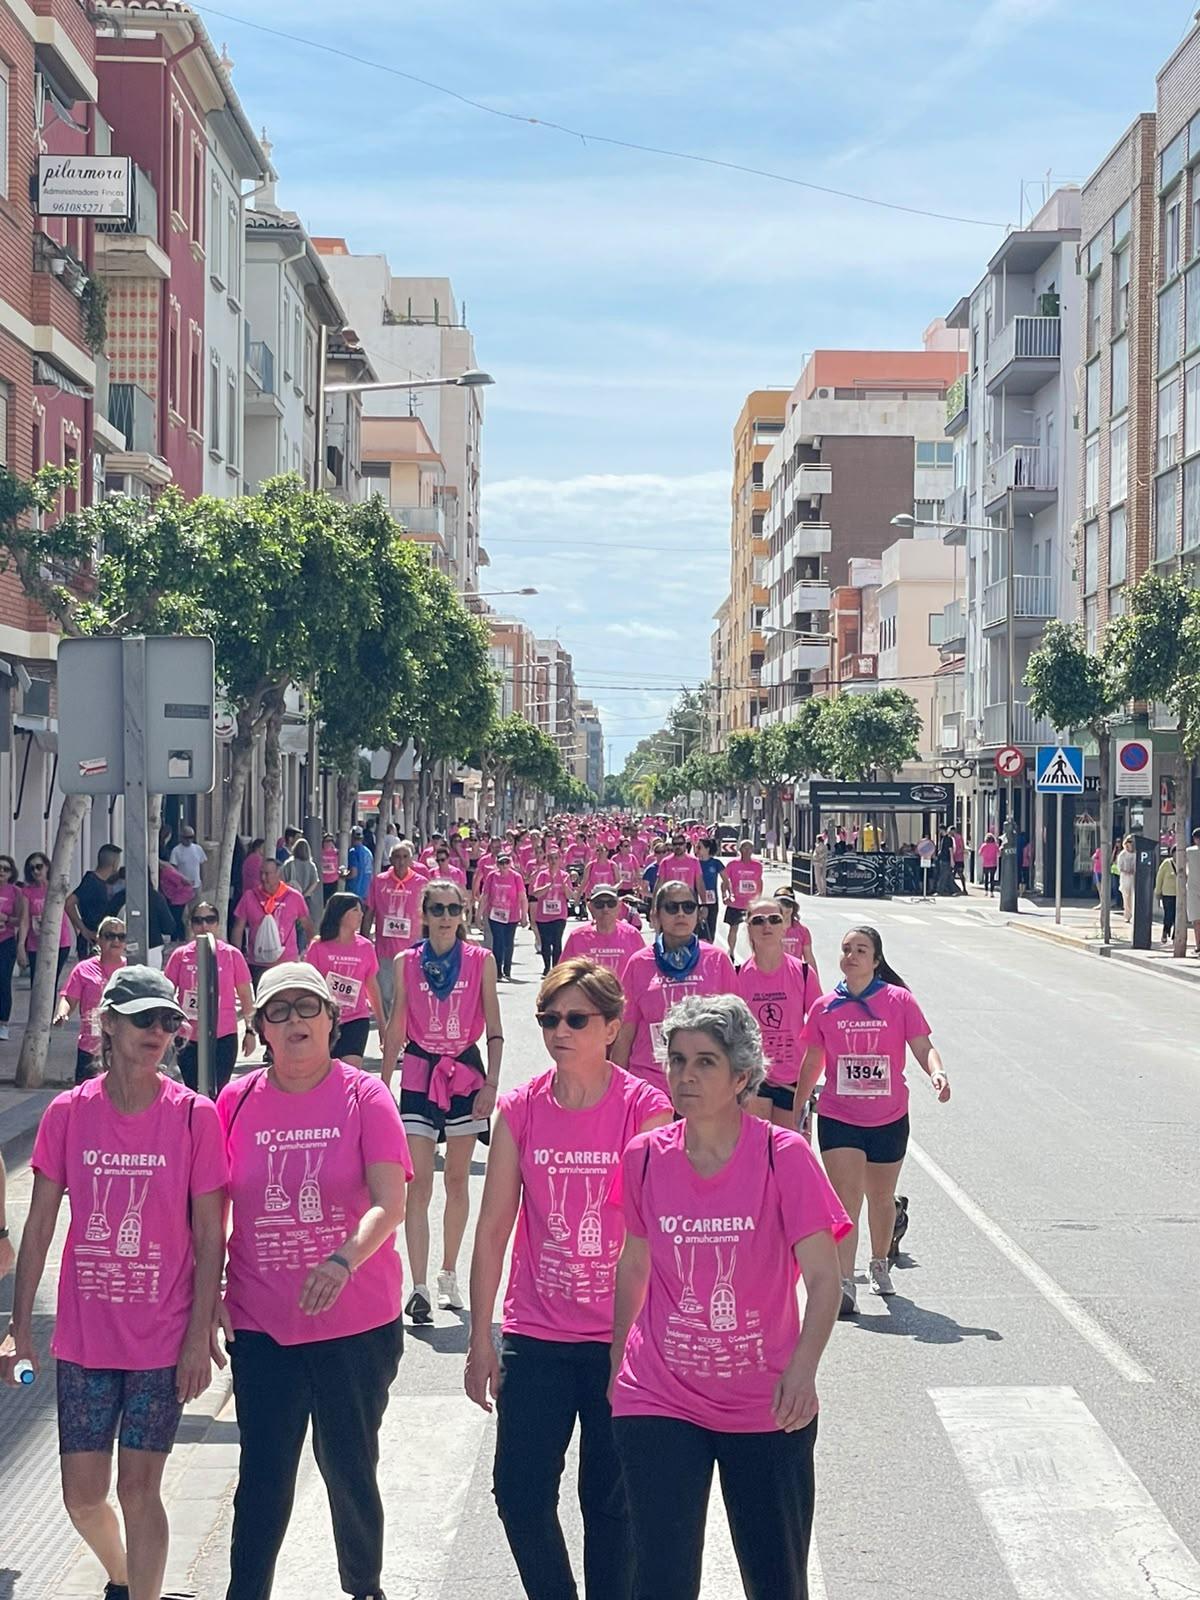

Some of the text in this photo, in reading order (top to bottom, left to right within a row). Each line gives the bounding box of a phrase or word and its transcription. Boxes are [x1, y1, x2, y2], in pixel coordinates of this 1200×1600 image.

[43, 159, 122, 187] pilarmora
[43, 188, 124, 197] Administradora Fincas
[52, 203, 104, 213] 961085271
[332, 981, 353, 994] 308
[849, 1020, 888, 1028] CARRERA
[846, 1065, 883, 1079] 1394
[276, 1127, 341, 1142] CARRERA
[101, 1153, 167, 1167] CARRERA
[554, 1151, 620, 1164] CARRERA
[682, 1216, 755, 1232] CARRERA
[685, 1234, 740, 1243] amuhcanma
